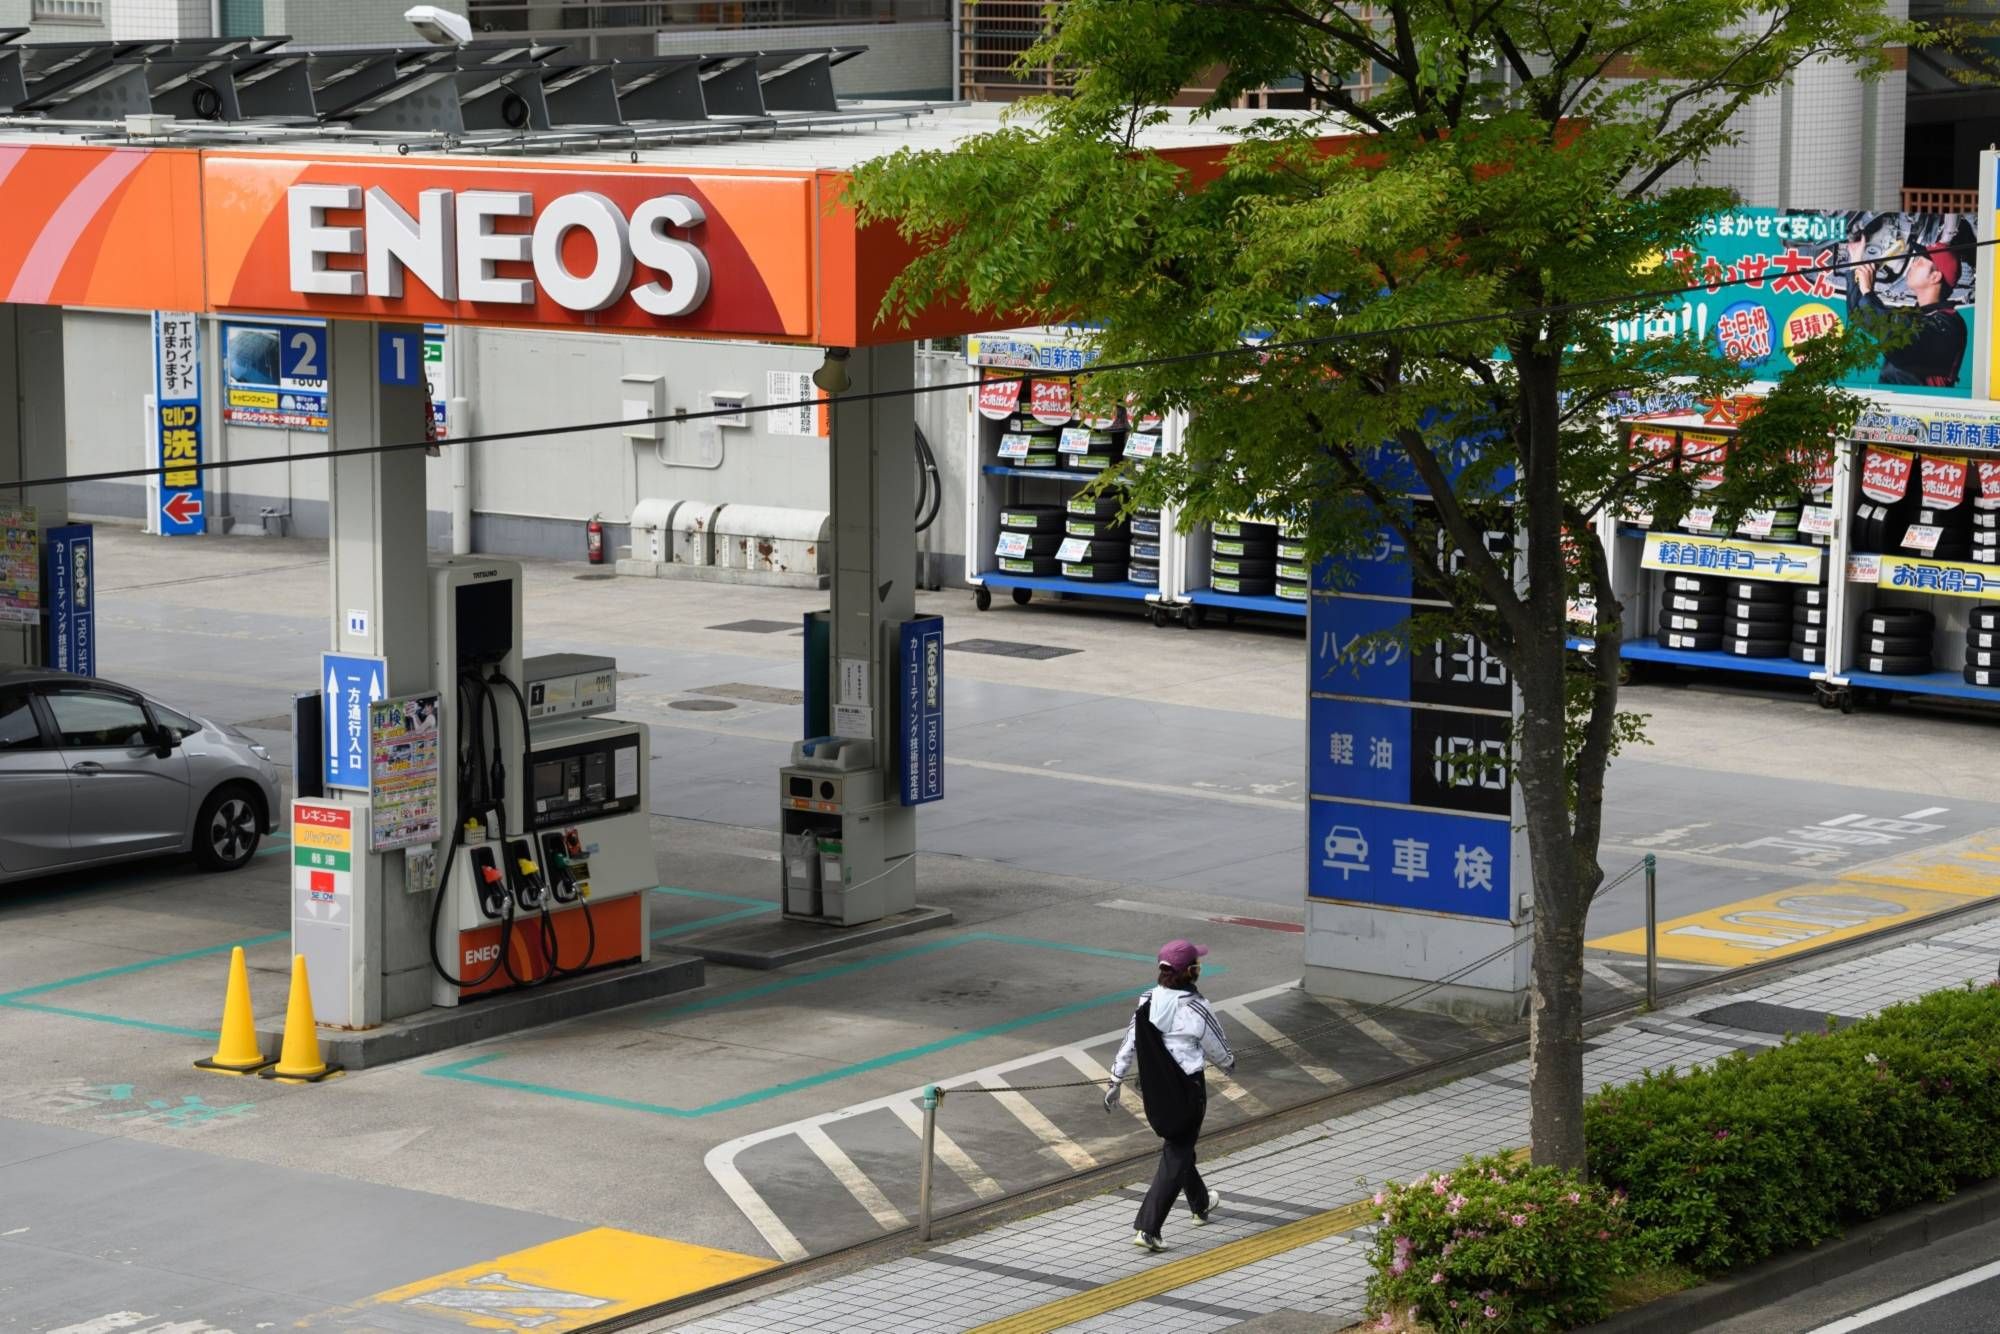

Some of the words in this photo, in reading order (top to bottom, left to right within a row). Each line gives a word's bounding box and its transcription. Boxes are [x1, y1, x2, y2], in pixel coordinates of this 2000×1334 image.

[288, 184, 711, 317] ENEOS
[179, 321, 193, 390] Tポイント
[290, 332, 318, 375] 2
[392, 337, 405, 380] 1
[1033, 383, 1068, 400] タイヤ
[161, 406, 197, 427] セルフ
[1929, 421, 2000, 448] 日新商事
[162, 428, 199, 488] 洗車
[1866, 452, 1907, 476] タイヤ
[1920, 461, 1962, 482] タイヤ
[1658, 540, 1808, 574] 軽自動車コーナー
[78, 647, 87, 678] SHO
[926, 640, 939, 708] KeePer
[347, 676, 362, 769] 一方通行入口
[928, 720, 937, 751] PRO
[1329, 732, 1394, 771] 軽油
[928, 754, 937, 793] SHOP
[301, 809, 344, 823] レギュラー
[1391, 838, 1494, 893] 車検
[465, 944, 501, 965] ENEO
